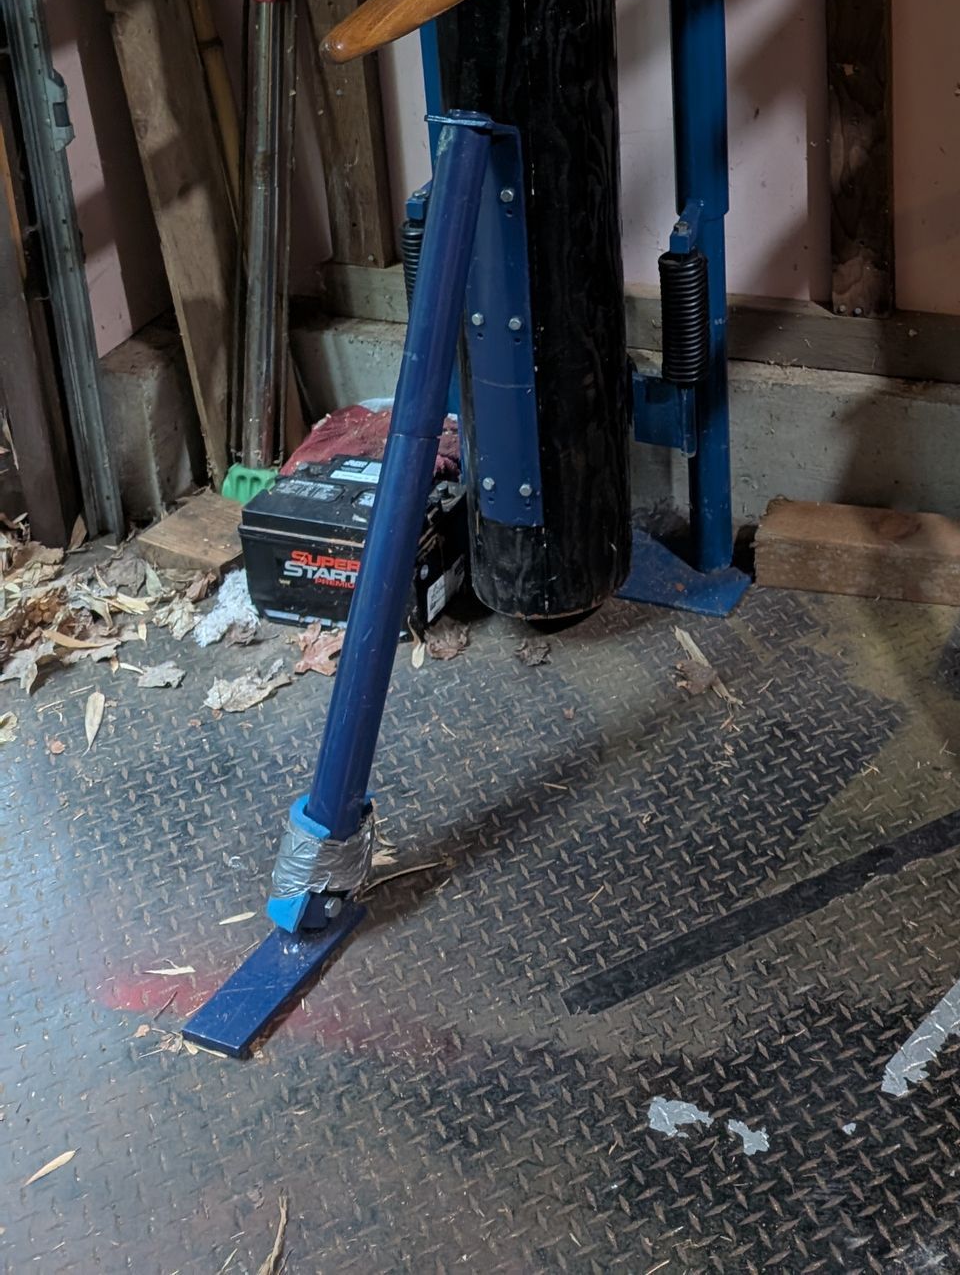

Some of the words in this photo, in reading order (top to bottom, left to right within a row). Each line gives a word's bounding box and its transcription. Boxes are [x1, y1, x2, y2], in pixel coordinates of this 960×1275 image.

[283, 560, 359, 583] START
[291, 550, 361, 572] SUPER
[314, 577, 355, 589] PREMIU
